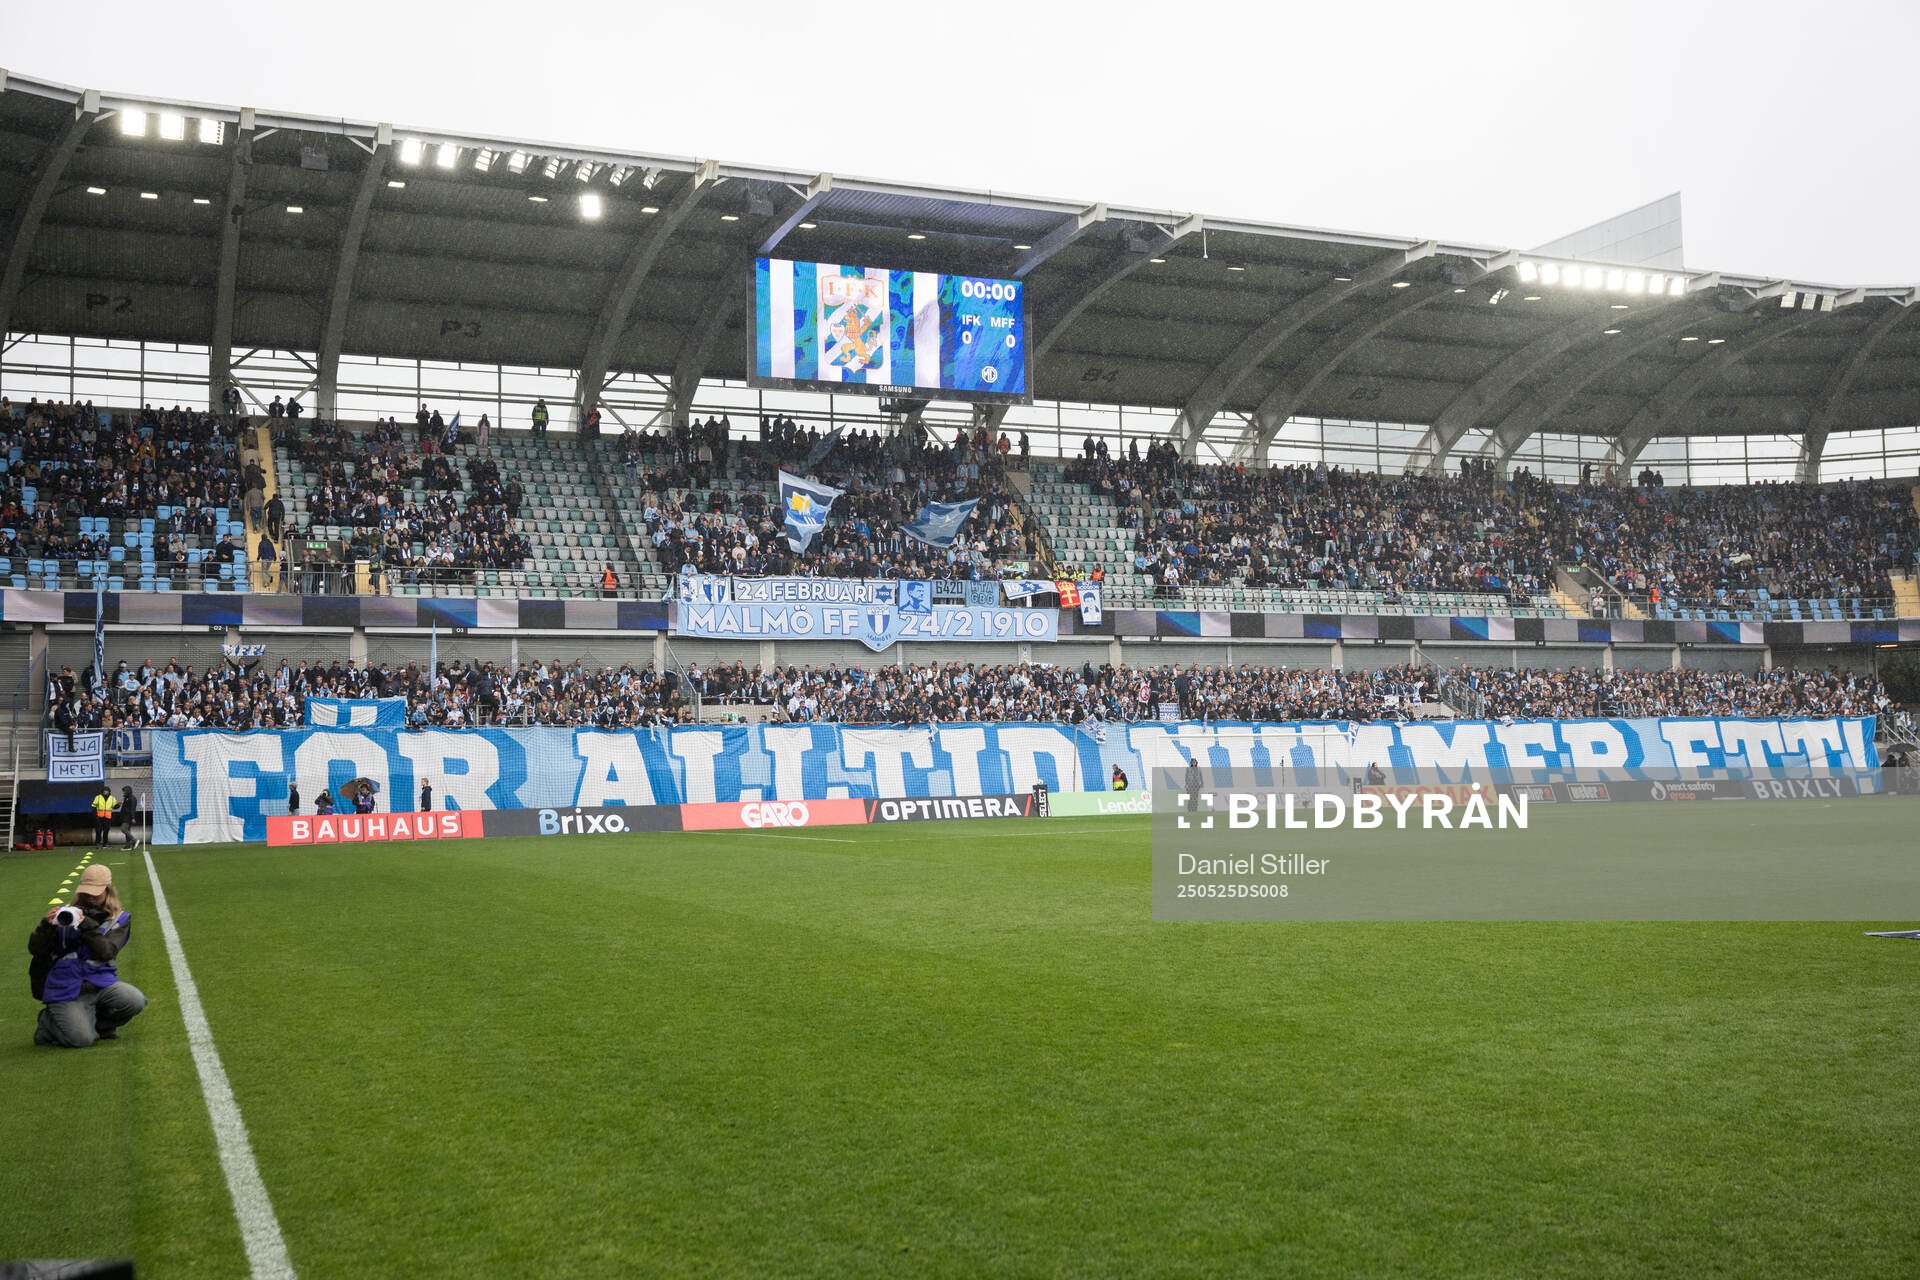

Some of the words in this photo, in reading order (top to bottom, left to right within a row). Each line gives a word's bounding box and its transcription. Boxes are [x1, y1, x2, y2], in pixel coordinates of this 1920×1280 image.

[961, 280, 1016, 301] 00:00
[86, 293, 133, 313] P2
[440, 319, 483, 338] P3
[962, 314, 981, 327] IFK
[990, 316, 1015, 329] MFF
[962, 331, 972, 345] 0
[1005, 334, 1016, 348] 0
[879, 385, 913, 394] SAMSUNG
[936, 580, 963, 594] 6420
[687, 604, 814, 635] MALMÖ
[822, 607, 860, 635] FF
[899, 609, 973, 637] 24/2
[981, 610, 1049, 637] 1910
[182, 702, 501, 844] FÖR
[575, 727, 1083, 807] ALLTID
[1130, 721, 1630, 790] NUMMER
[1661, 720, 1875, 794] ETT!
[1570, 785, 1598, 799] weber
[1669, 791, 1696, 801] group
[1752, 779, 1842, 799] BRIXLY
[881, 797, 1022, 821] OPTIMERA
[1038, 786, 1048, 818] SELECT
[538, 808, 631, 836] Brixo.
[741, 802, 809, 828] GARO
[291, 811, 459, 840] BAUHAUS
